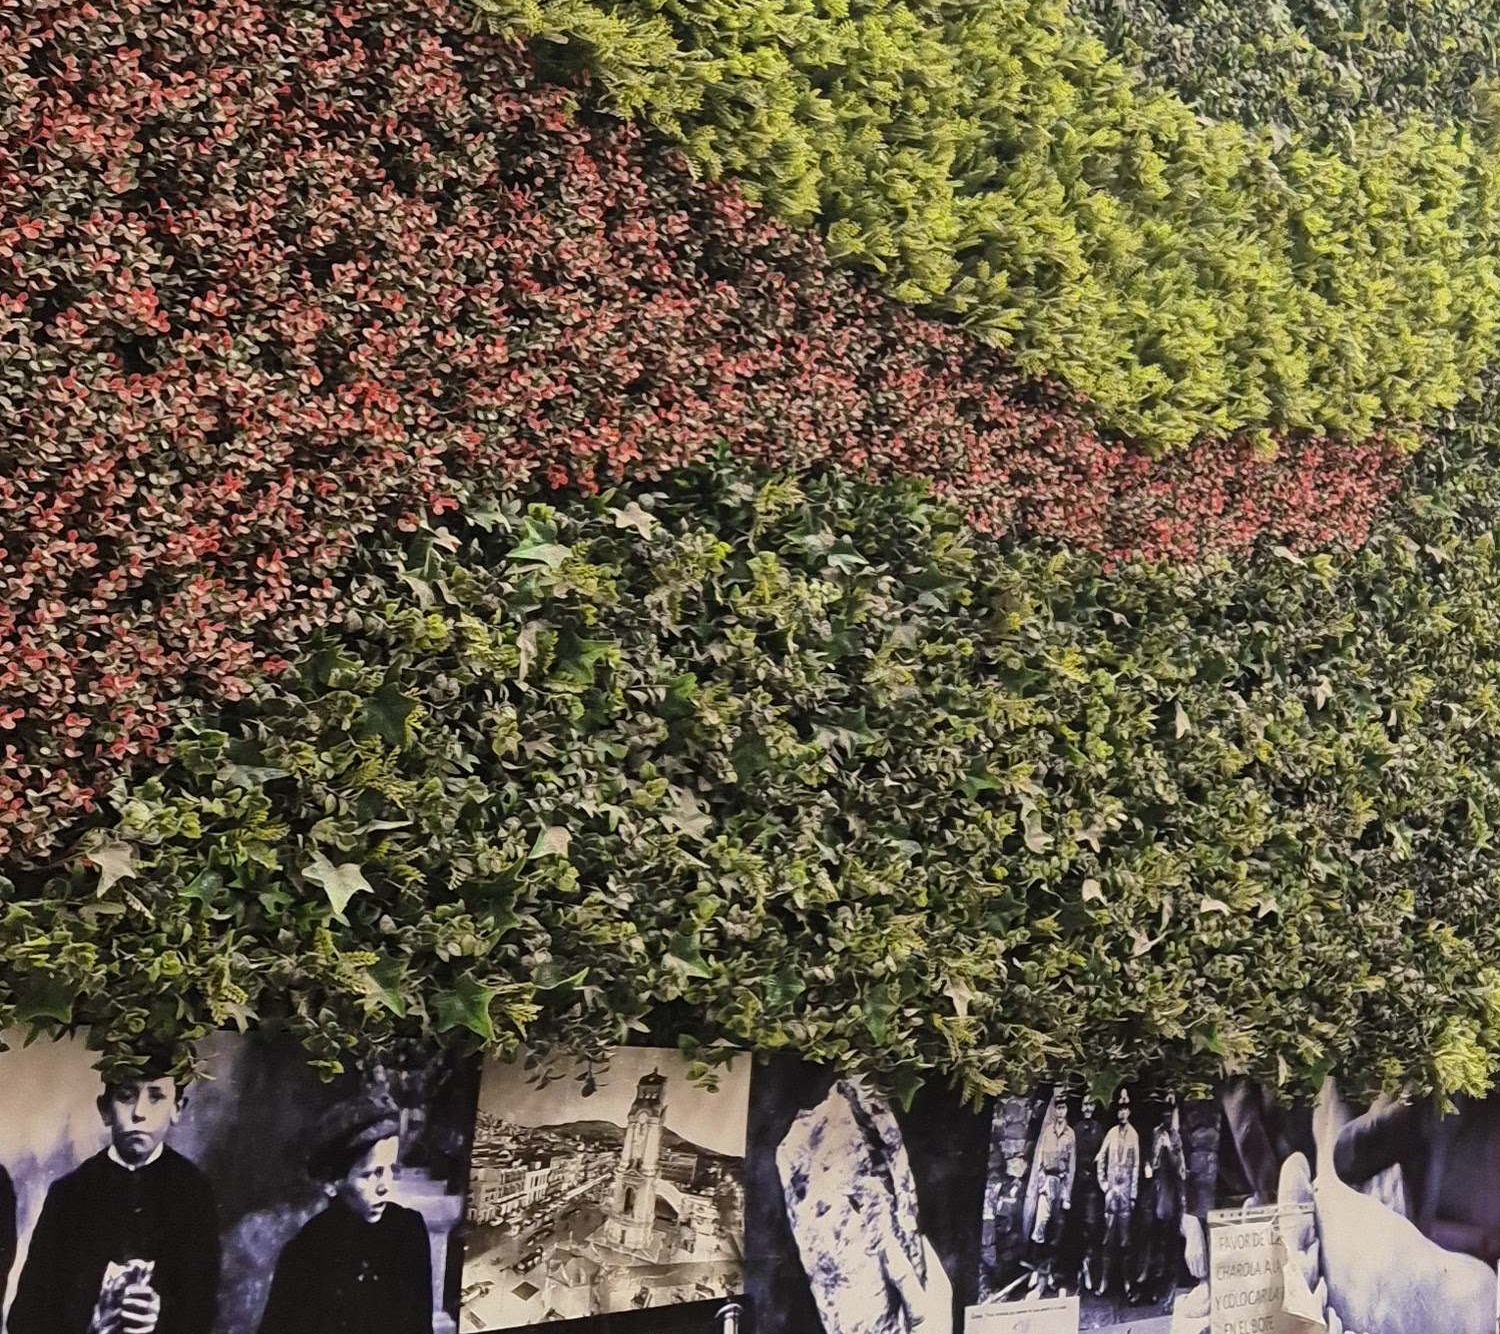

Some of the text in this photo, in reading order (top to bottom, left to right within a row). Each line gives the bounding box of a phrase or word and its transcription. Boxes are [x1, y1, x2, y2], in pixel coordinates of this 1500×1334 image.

[1219, 1232, 1251, 1251] FAVOR
[1252, 1232, 1266, 1248] DE
[1215, 1295, 1221, 1311] Y
[1222, 1288, 1268, 1310] COLOCAR
